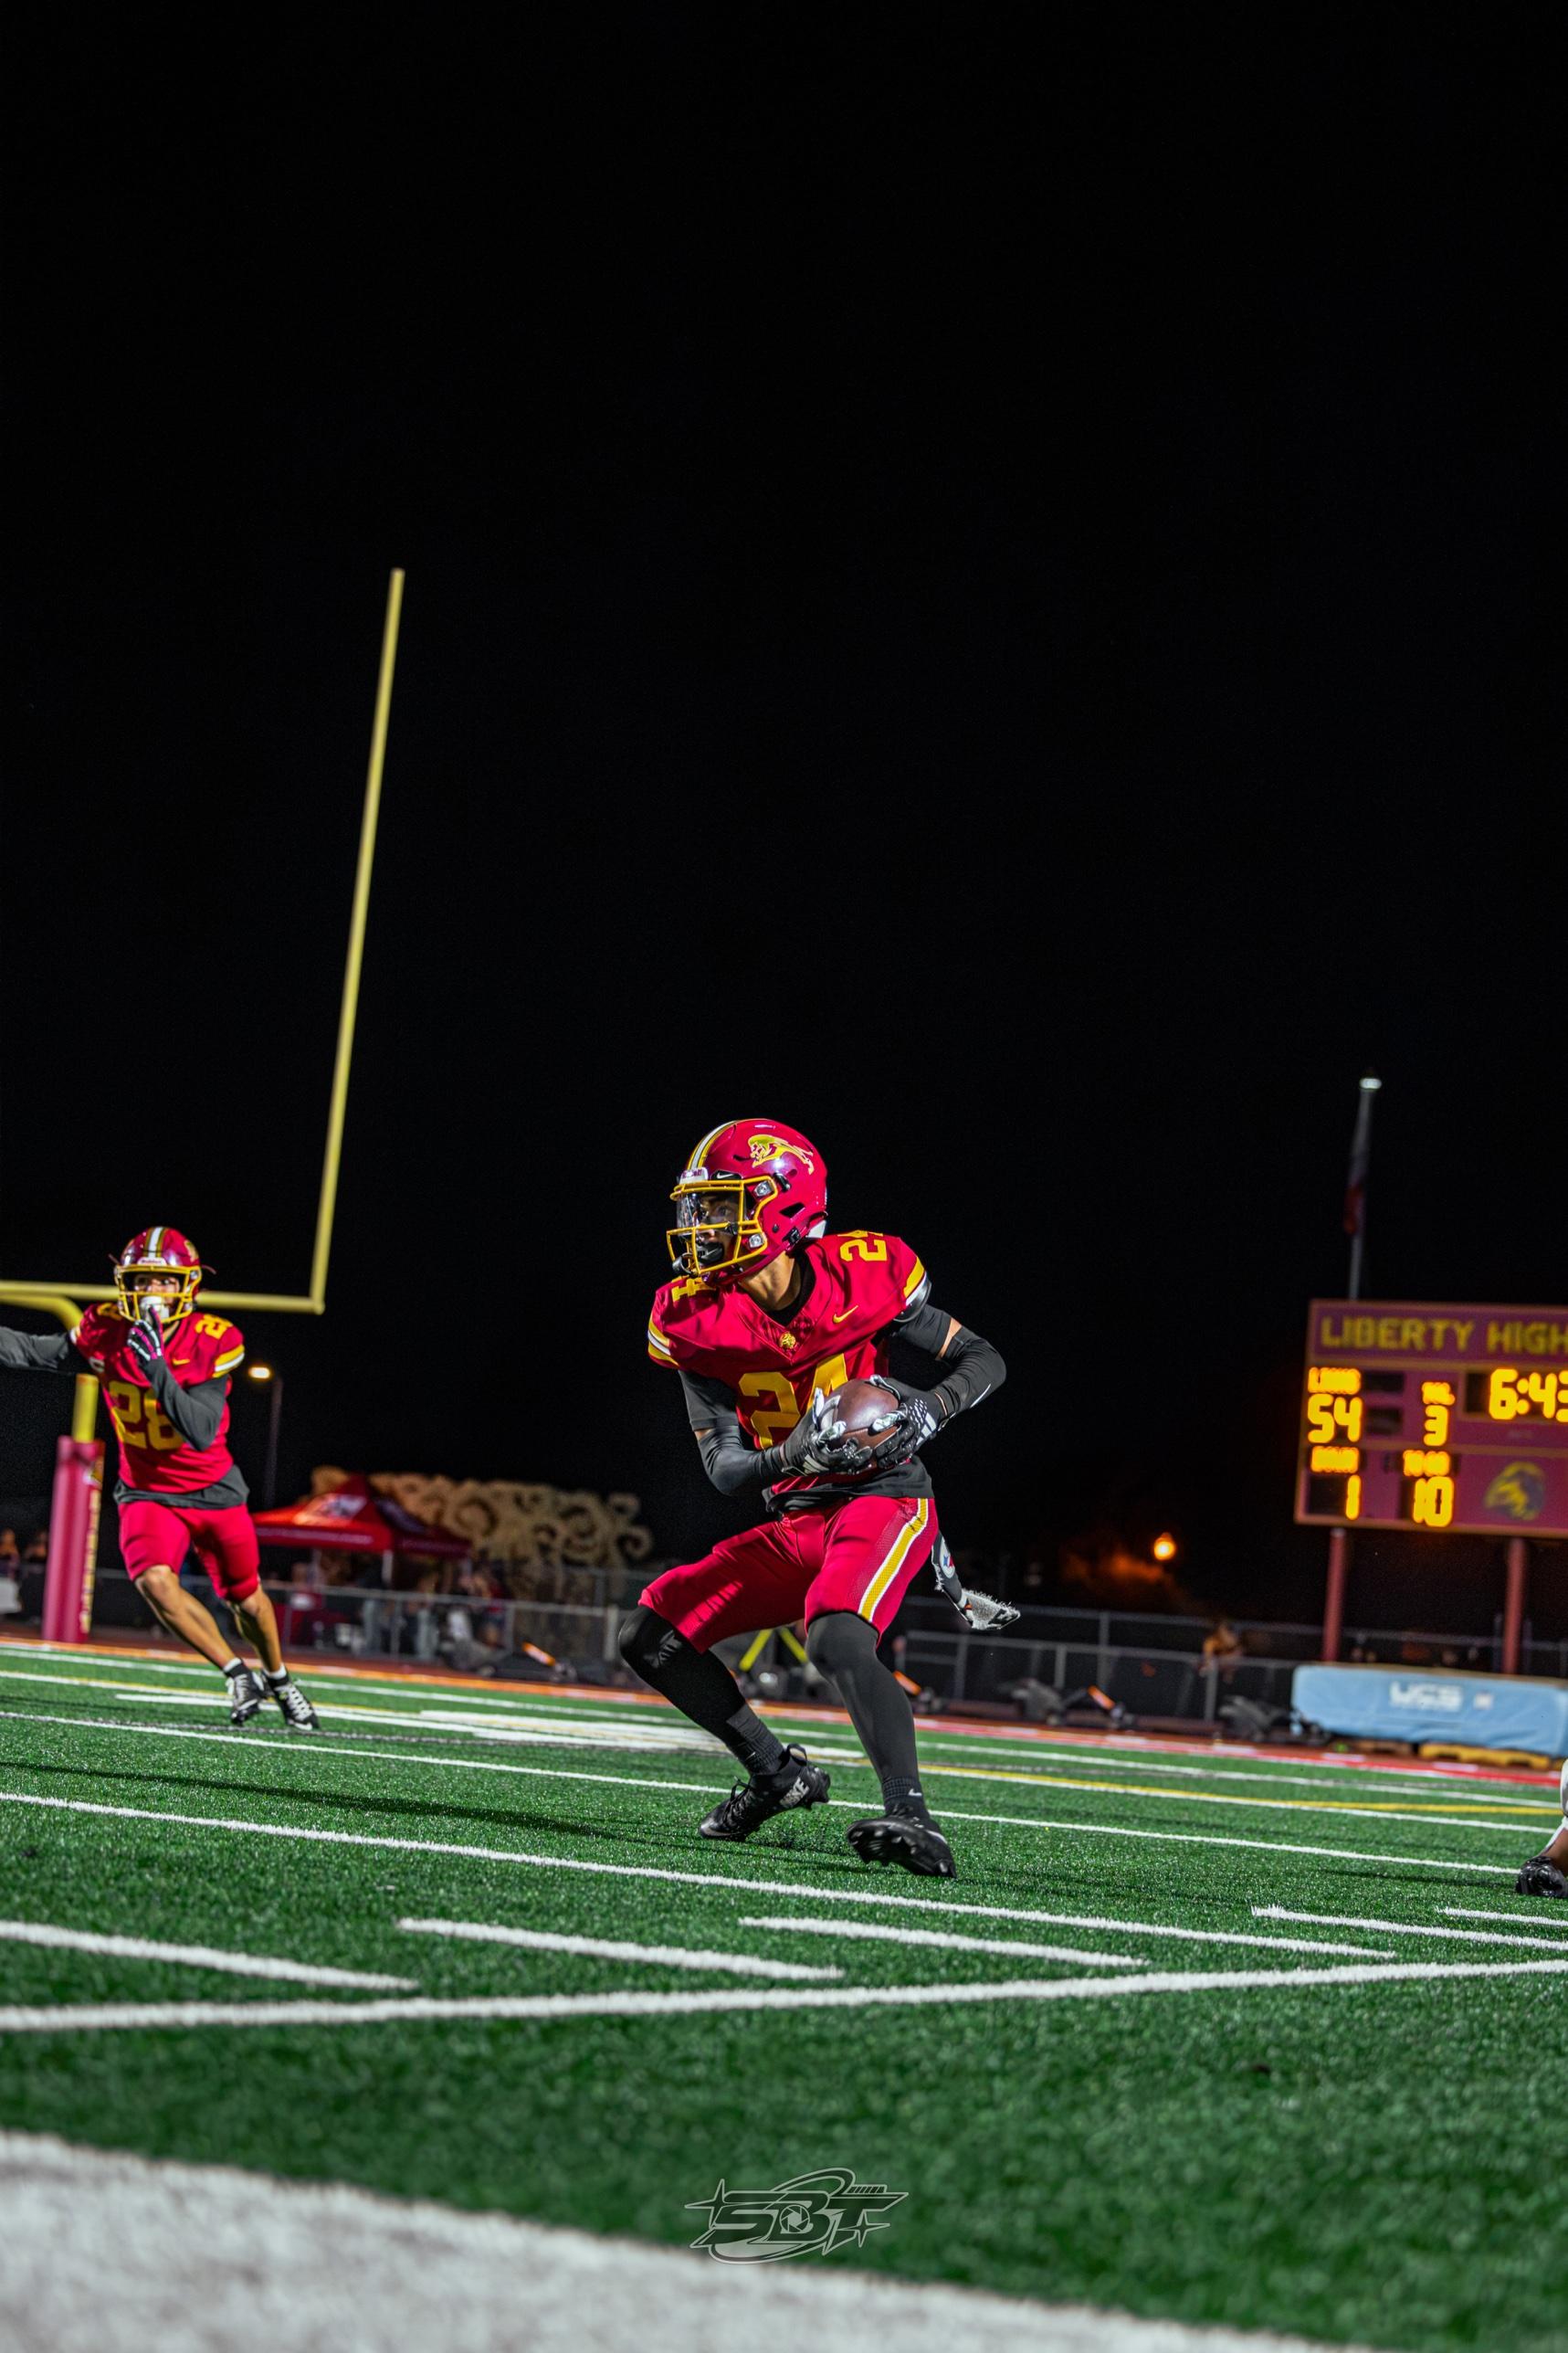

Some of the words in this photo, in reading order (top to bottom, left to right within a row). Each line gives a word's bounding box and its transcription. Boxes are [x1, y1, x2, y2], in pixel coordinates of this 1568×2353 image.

[1321, 1315, 1474, 1351] LIBERTY
[1486, 1320, 1568, 1356] HIGH
[1308, 1393, 1363, 1443] 54
[1423, 1405, 1448, 1447] 3
[1345, 1474, 1361, 1520] 1
[1413, 1475, 1455, 1527] 10
